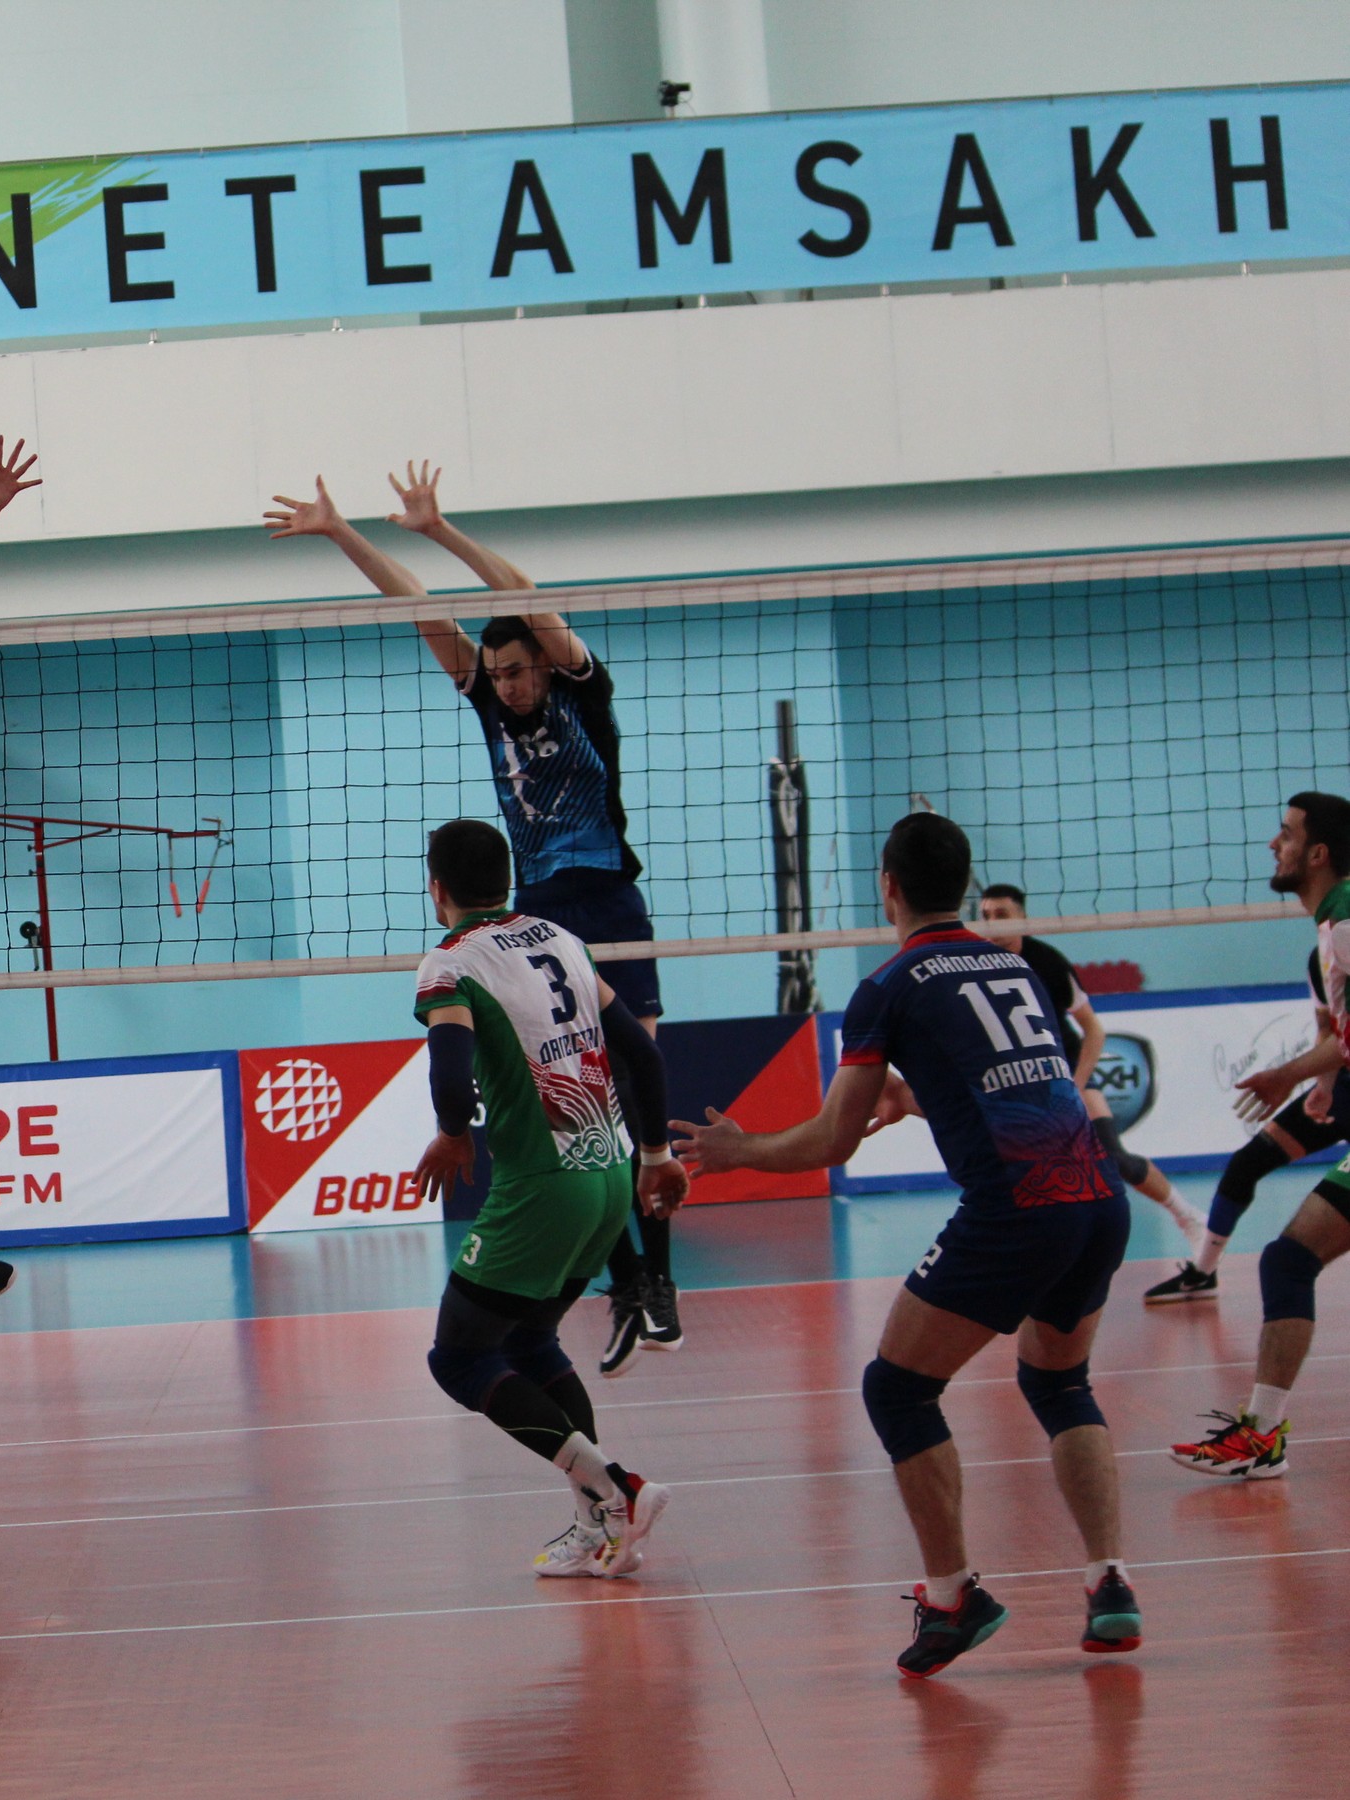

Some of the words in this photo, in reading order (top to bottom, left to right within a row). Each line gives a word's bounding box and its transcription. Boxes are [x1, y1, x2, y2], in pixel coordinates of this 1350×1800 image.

[526, 953, 578, 1025] 3
[957, 977, 1058, 1052] 12
[313, 1171, 424, 1217] ВФВ
[462, 1233, 482, 1265] 3
